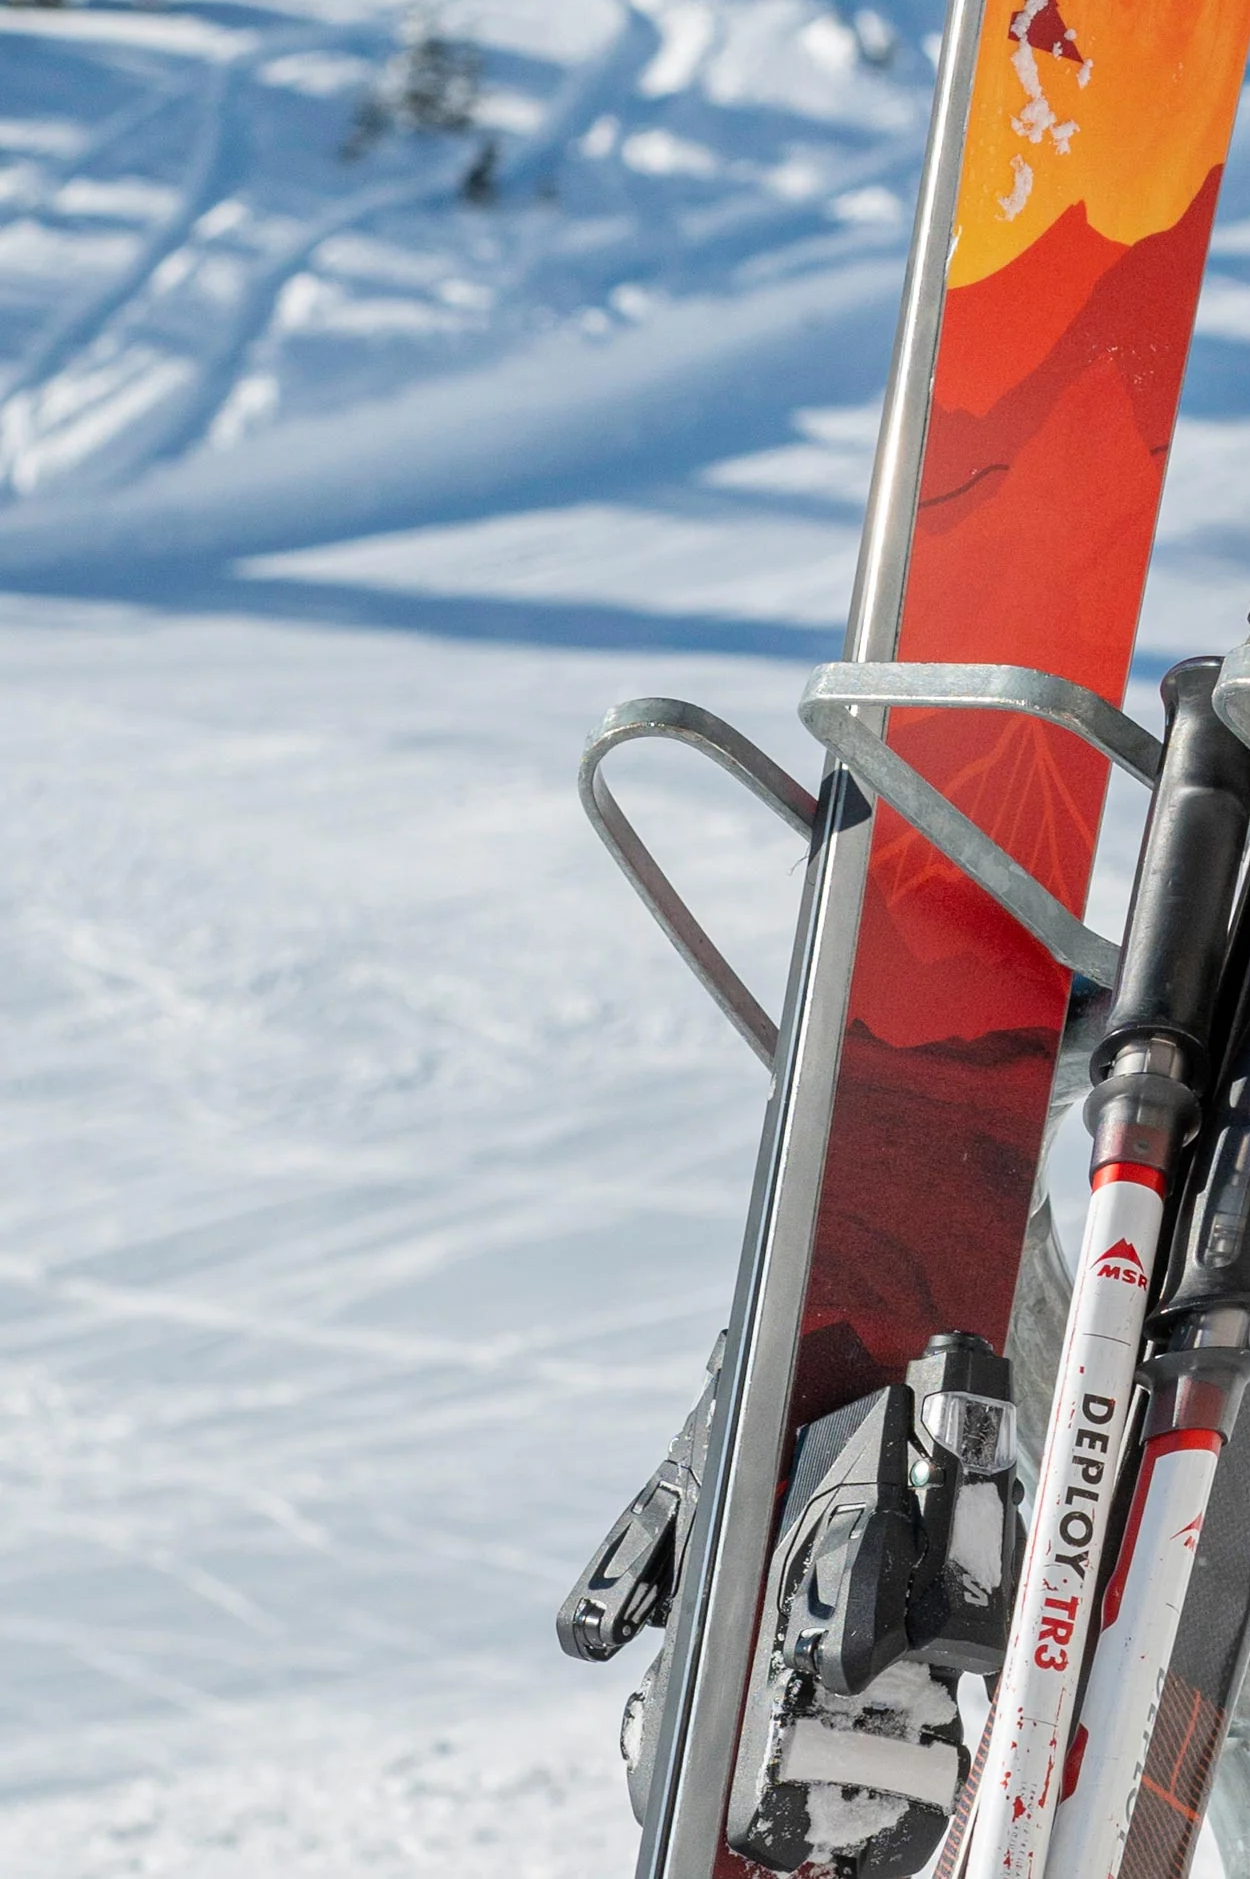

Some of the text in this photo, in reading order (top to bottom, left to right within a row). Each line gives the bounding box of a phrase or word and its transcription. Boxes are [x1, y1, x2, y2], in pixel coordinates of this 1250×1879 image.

[1096, 1264, 1149, 1293] MSR
[1033, 1392, 1117, 1674] DEPLOY TR3
